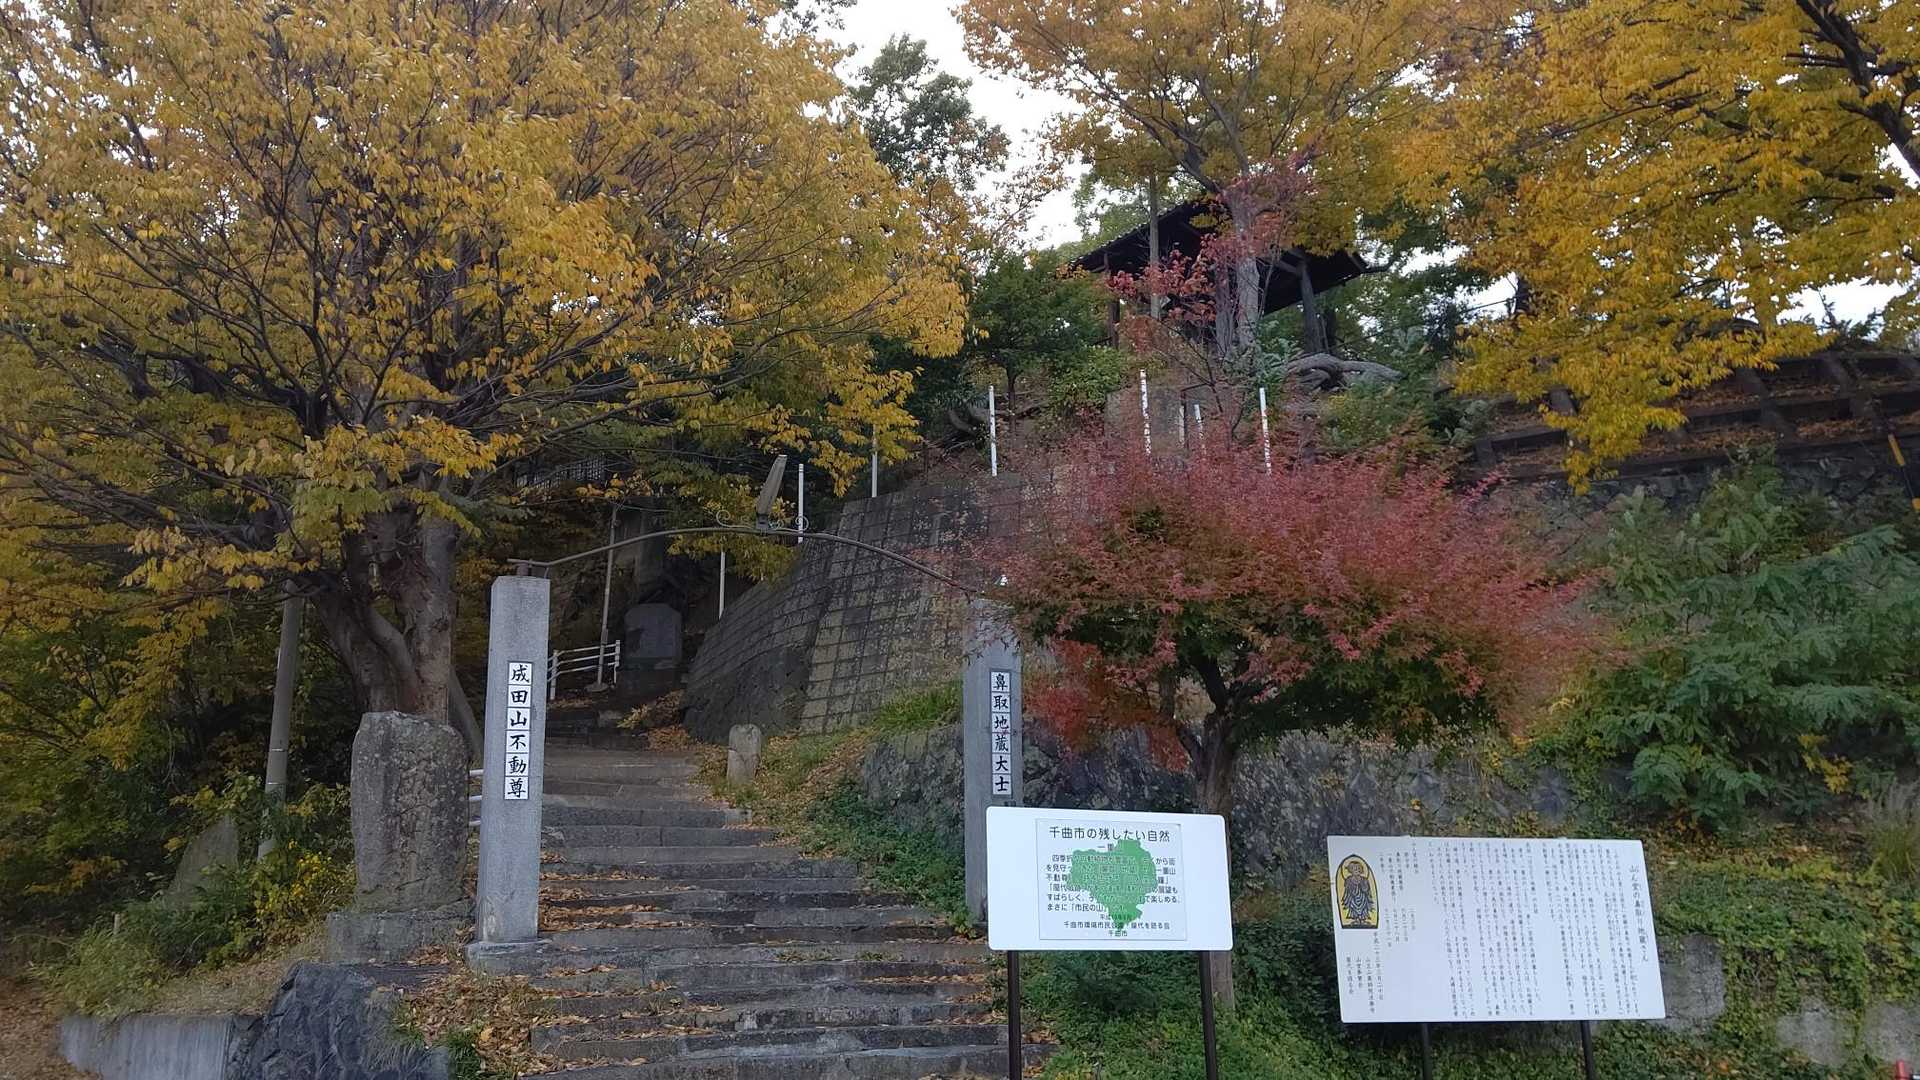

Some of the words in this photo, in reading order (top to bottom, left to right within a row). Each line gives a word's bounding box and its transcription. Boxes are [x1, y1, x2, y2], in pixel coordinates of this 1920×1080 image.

[507, 664, 531, 799] 成田山不動尊
[993, 672, 1010, 792] 鼻取地蔵大士
[1049, 826, 1170, 842] 千曲市の残したい自然
